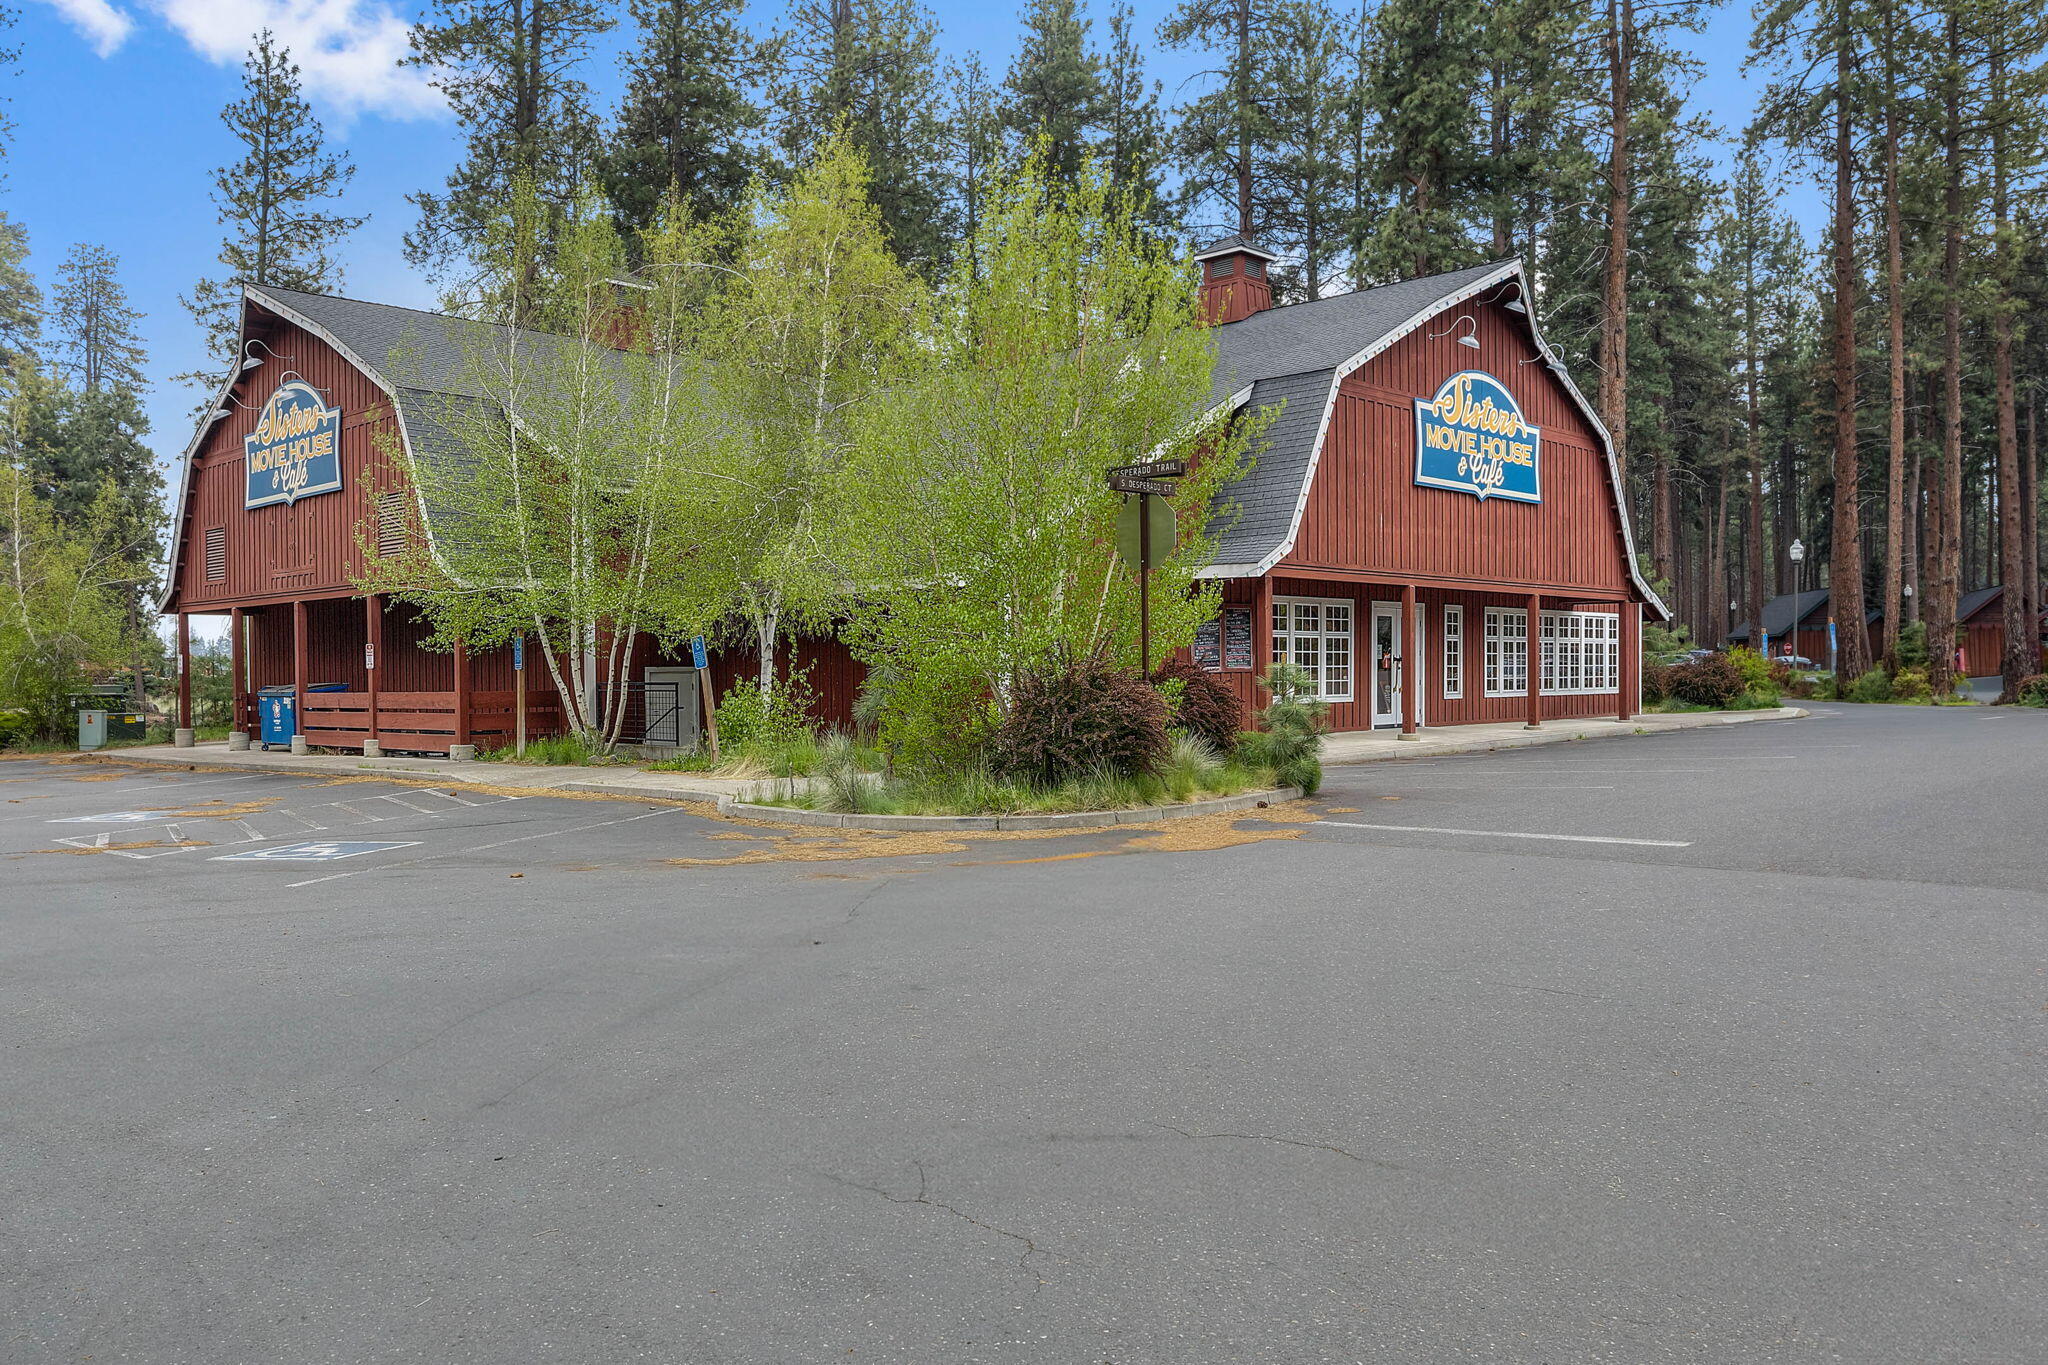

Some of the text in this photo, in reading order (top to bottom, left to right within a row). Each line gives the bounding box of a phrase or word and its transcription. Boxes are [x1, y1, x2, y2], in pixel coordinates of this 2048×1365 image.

[255, 393, 327, 445] Sisters
[1432, 373, 1527, 438] Sisters
[251, 430, 333, 474] MOVIE HOUSE
[1426, 423, 1532, 467] MOVIE HOUSE
[280, 460, 308, 496] Café
[1120, 462, 1176, 477] SPERADO TRAIL
[1129, 480, 1160, 492] DESPERADO
[1164, 484, 1172, 492] CT
[1458, 452, 1504, 494] & Café
